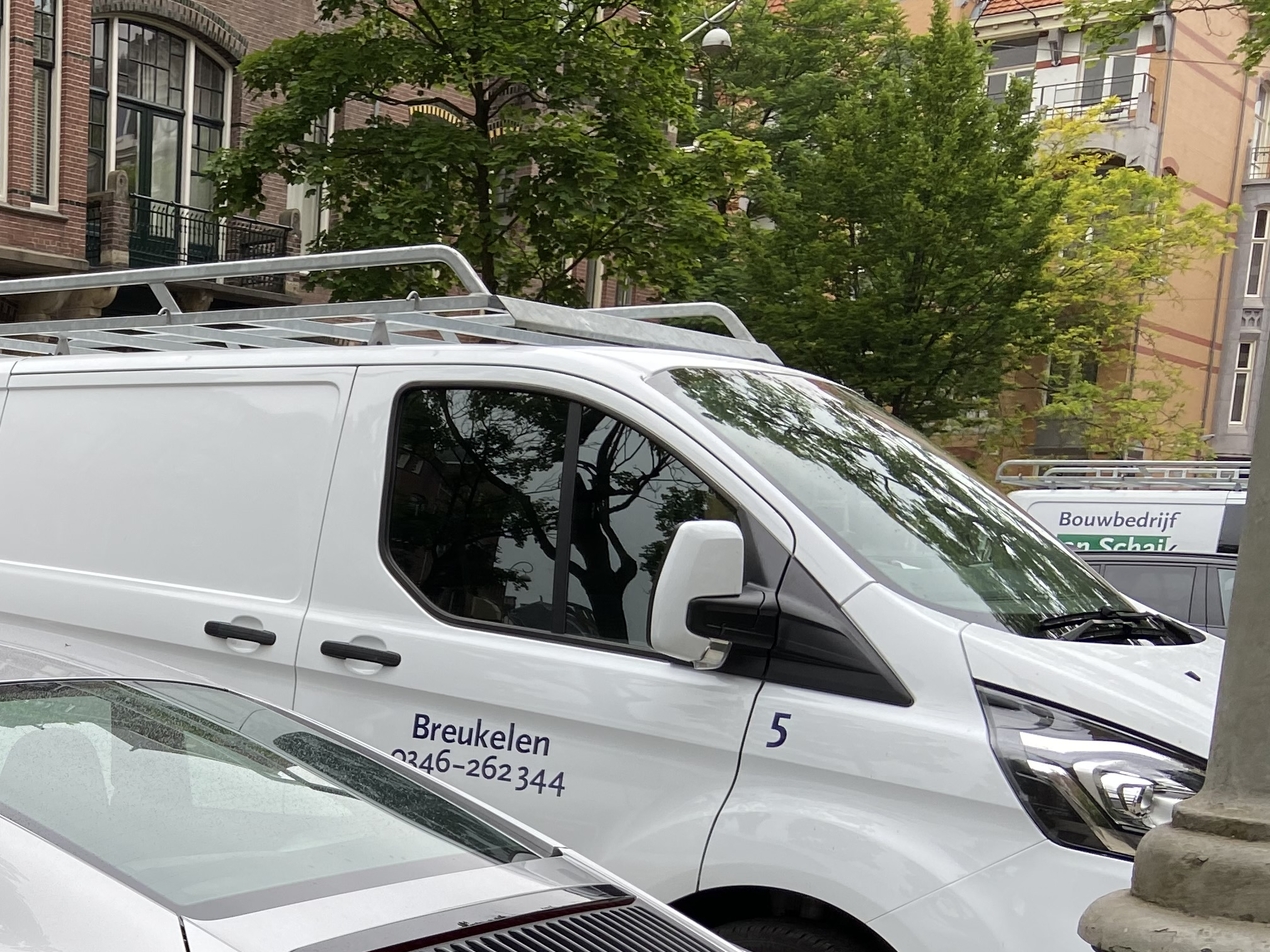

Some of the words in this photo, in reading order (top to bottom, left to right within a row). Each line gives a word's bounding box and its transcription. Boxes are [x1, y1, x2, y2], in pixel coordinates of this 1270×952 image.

[1058, 511, 1181, 532] Bouwbedrijf
[412, 713, 550, 756] Breukelen
[765, 711, 792, 748] 5
